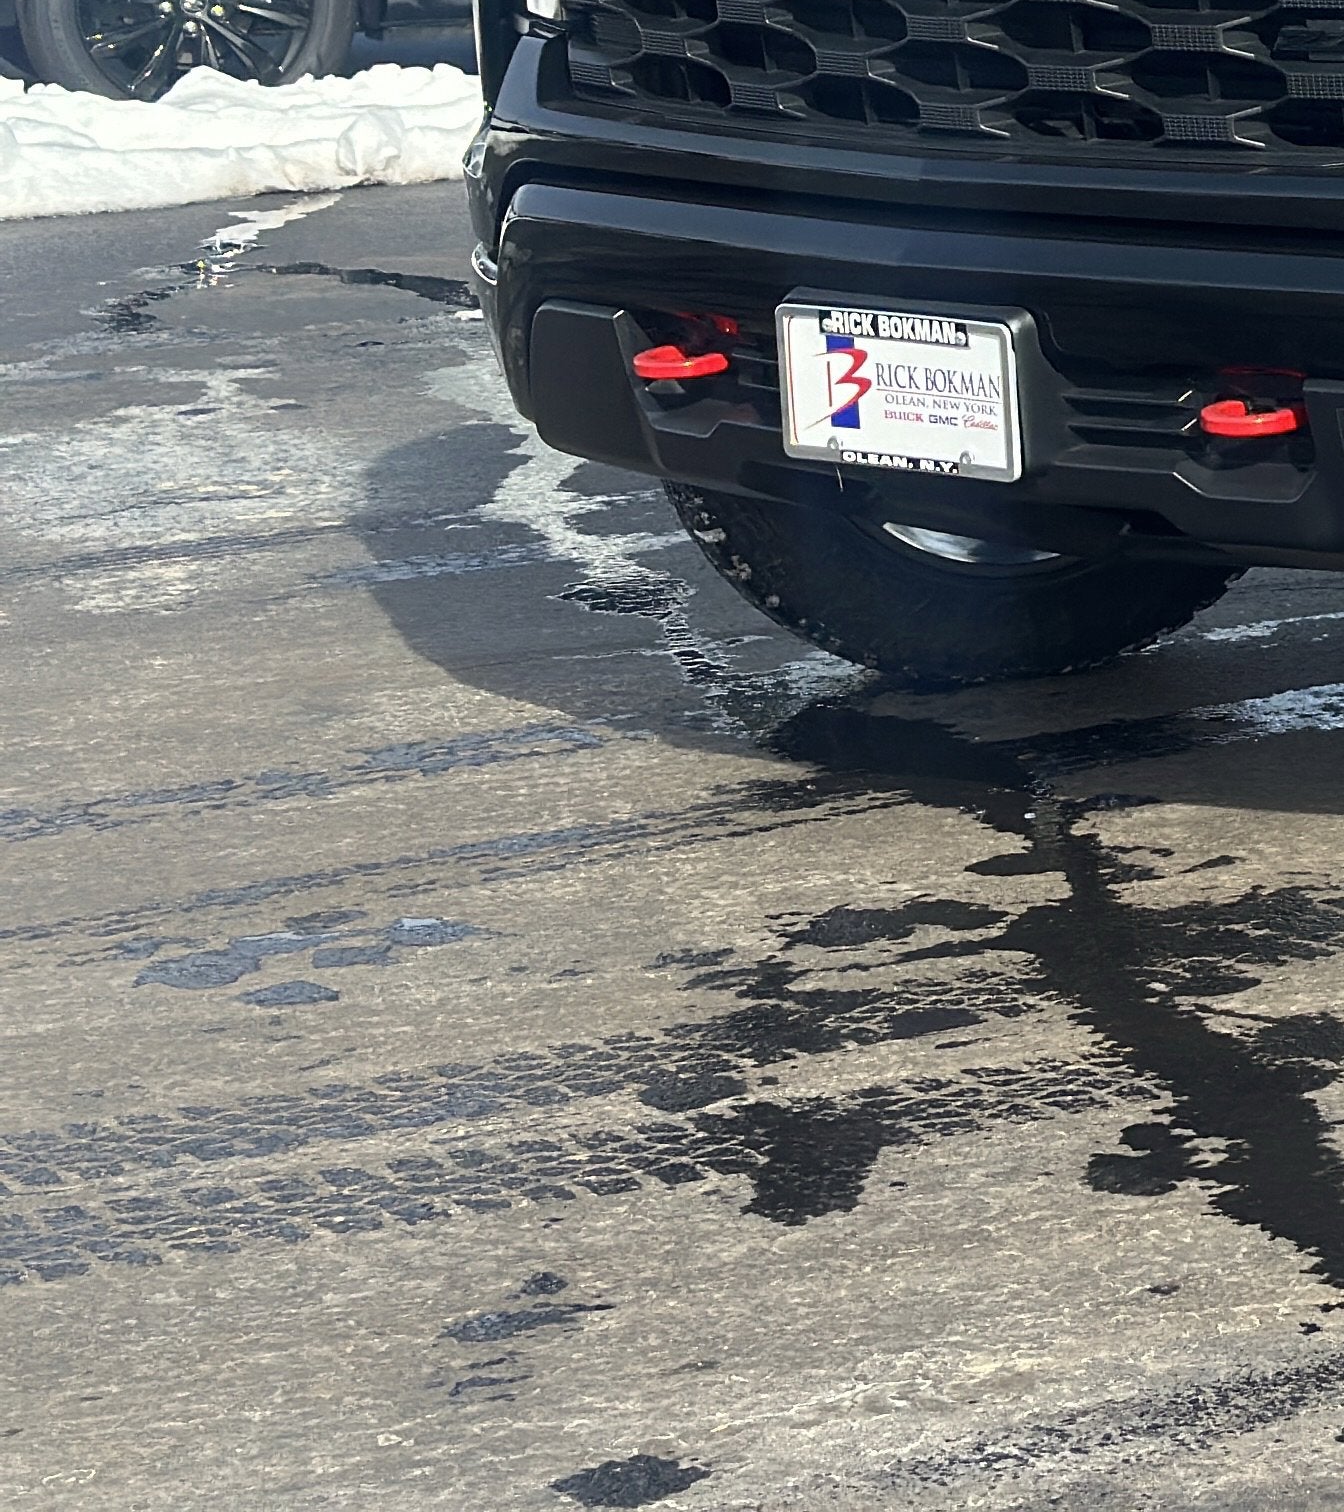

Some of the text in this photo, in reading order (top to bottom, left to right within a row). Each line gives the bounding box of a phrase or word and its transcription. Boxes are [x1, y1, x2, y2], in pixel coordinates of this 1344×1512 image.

[830, 310, 956, 345] RICK BOKMAN
[875, 362, 1001, 399] RICK BOKMAN
[884, 409, 924, 423] BUICK
[932, 399, 960, 411] NEW
[963, 402, 999, 417] YORK
[928, 414, 959, 426] GMC
[919, 459, 958, 474] N.Y.
